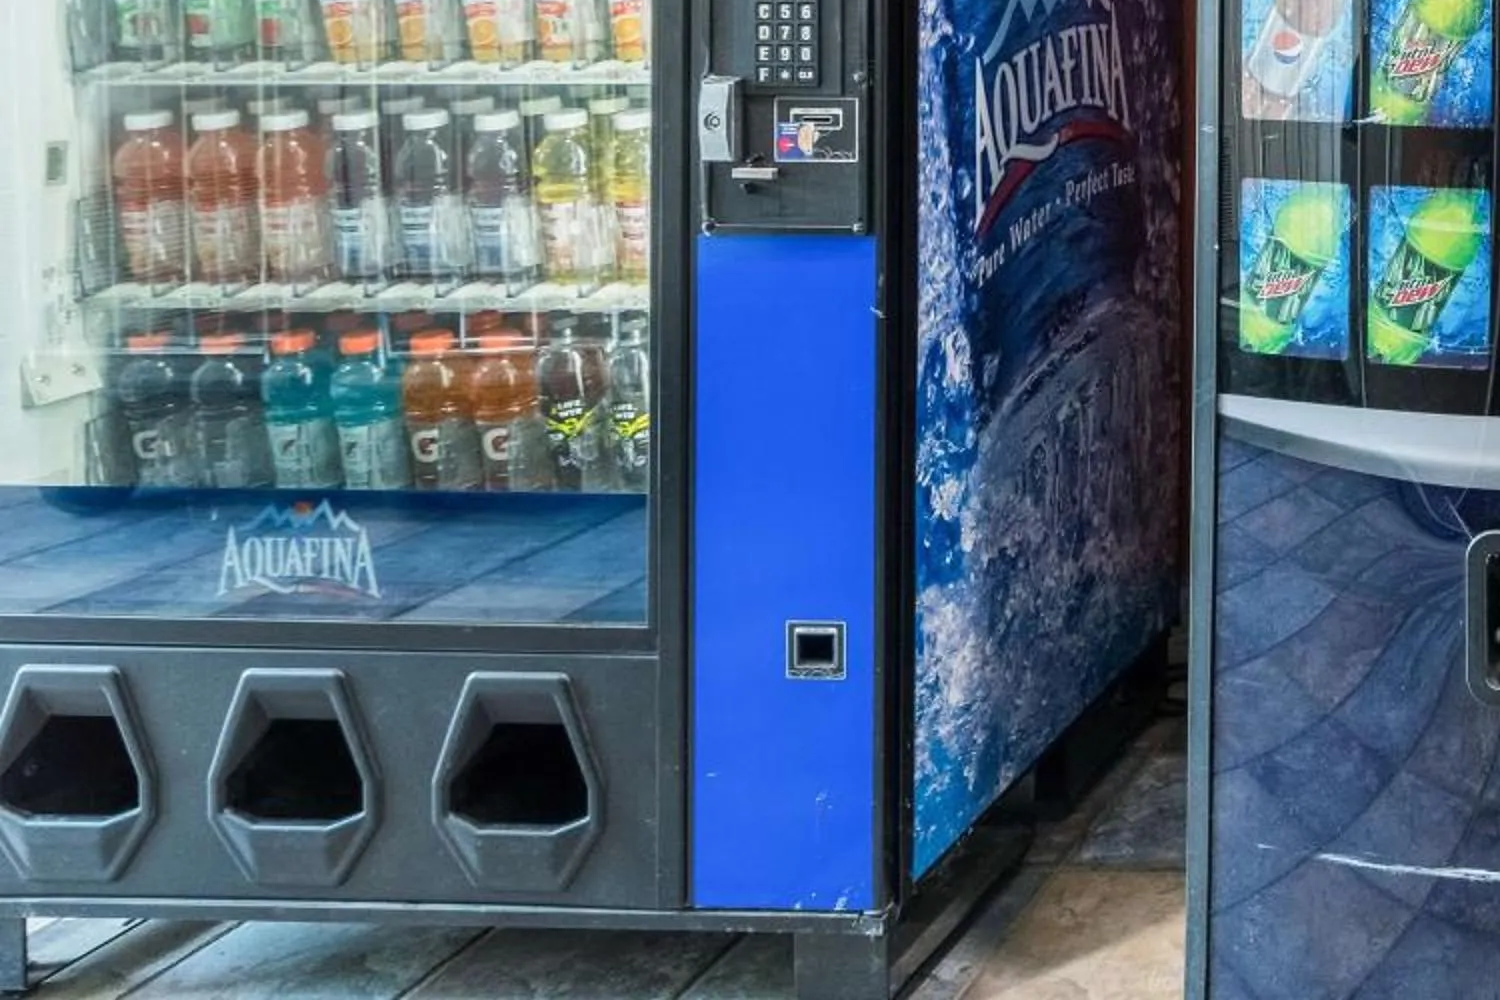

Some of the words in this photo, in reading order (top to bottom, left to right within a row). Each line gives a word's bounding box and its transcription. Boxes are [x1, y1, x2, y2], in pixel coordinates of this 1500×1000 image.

[759, 3, 769, 19] C
[780, 3, 791, 19] 5
[801, 3, 811, 19] 6
[758, 25, 769, 40] D
[781, 25, 791, 40] 7
[801, 25, 811, 40] 8
[759, 45, 769, 61] E
[781, 45, 790, 61] 9
[759, 67, 769, 82] F
[974, 1, 1130, 230] AQUAFINA
[977, 242, 1006, 289] Pure
[1008, 202, 1051, 253] Water
[1064, 169, 1110, 208] Perfect
[1111, 161, 1137, 187] Taste
[215, 525, 383, 599] AQUAFINA
